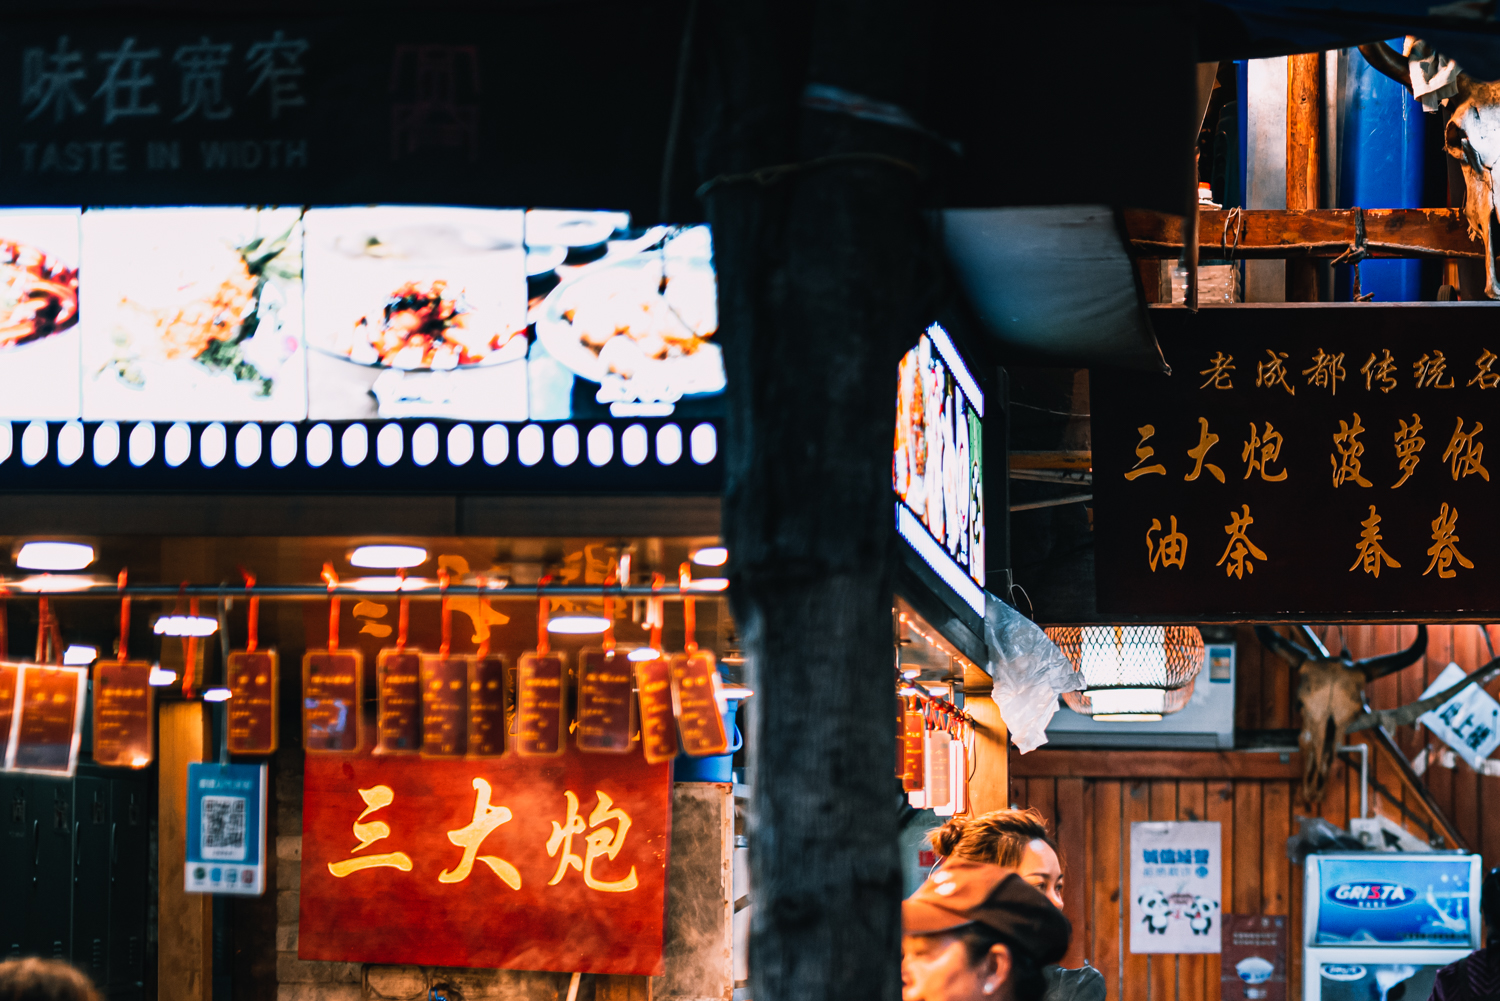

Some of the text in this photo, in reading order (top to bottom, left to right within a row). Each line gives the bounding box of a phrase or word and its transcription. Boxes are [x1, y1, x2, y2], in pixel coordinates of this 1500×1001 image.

[21, 29, 310, 125] 味在宽窄
[20, 140, 308, 172] TASTE IN WIDTH
[1124, 416, 1288, 483] 三大炮
[1330, 411, 1490, 489] 菠萝饭
[1146, 504, 1267, 580] 油茶
[1350, 502, 1474, 579] 春卷
[328, 777, 638, 892] 三大炮
[1336, 884, 1407, 901] GRISTA
